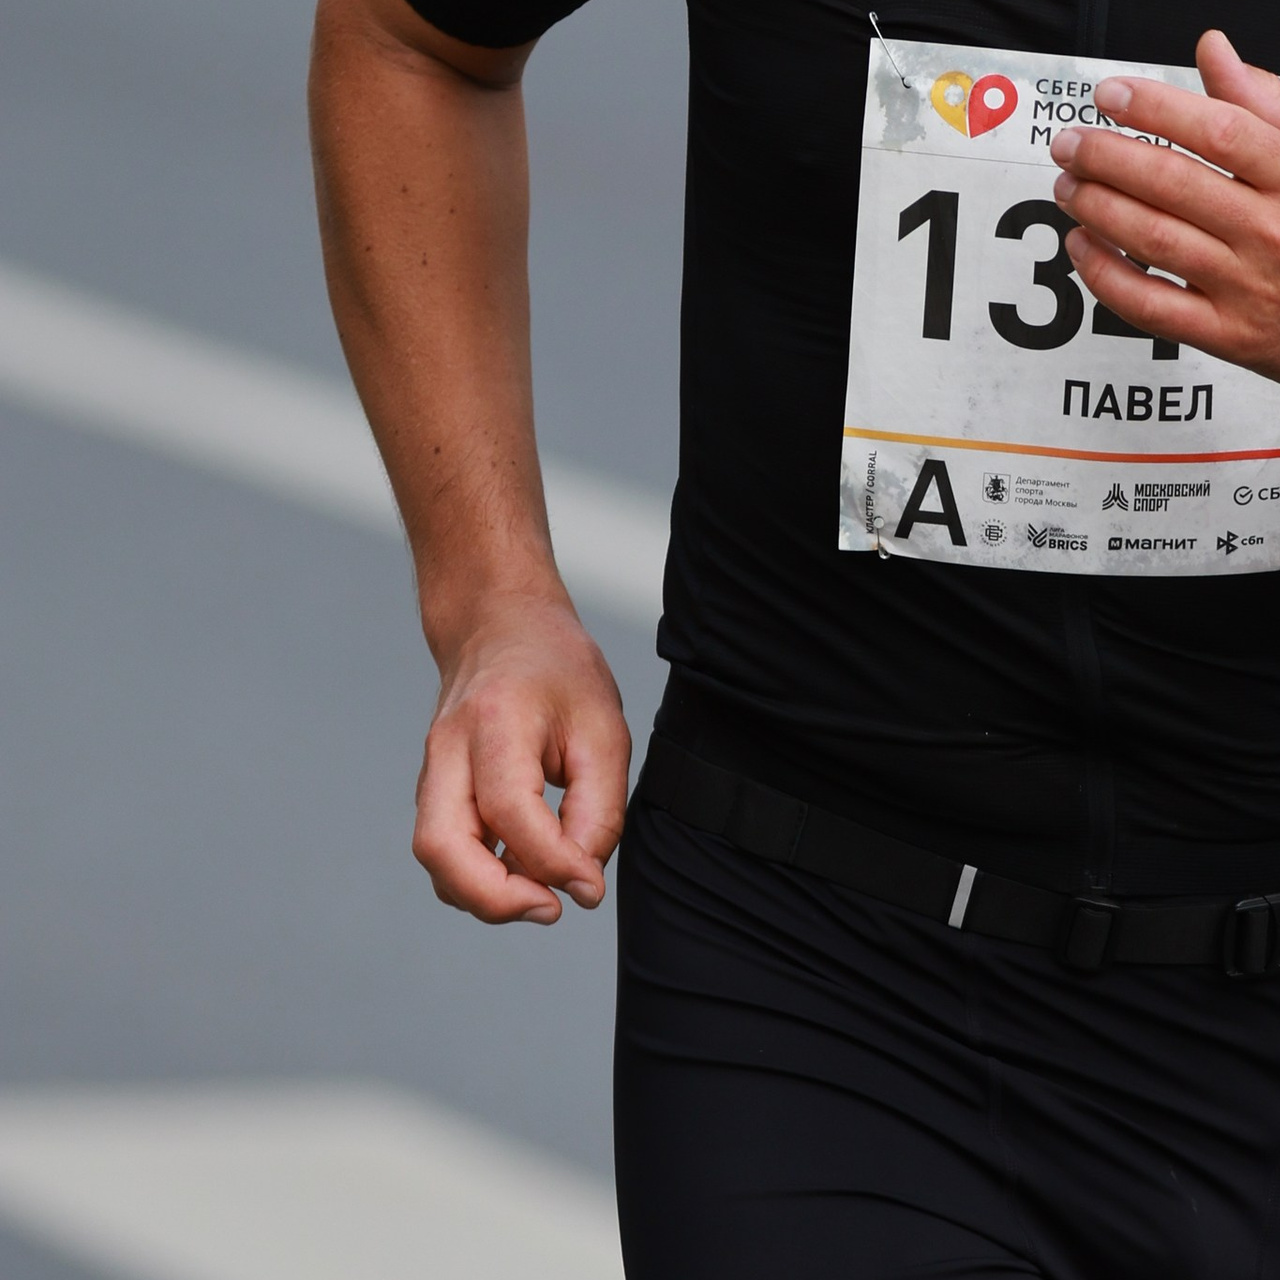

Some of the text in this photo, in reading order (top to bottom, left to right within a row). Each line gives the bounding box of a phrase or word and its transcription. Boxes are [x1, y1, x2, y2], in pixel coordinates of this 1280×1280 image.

[1062, 378, 1214, 422] ПАВЕЛ
[866, 450, 878, 488] CORRAL
[1015, 476, 1070, 488] Департамент
[1134, 480, 1211, 497] МОСКОВСКИЙ
[1015, 487, 1044, 496] спорта
[1014, 496, 1078, 508] города Москвы
[1133, 498, 1170, 512] СПОРТ
[865, 494, 876, 535] КЛАСТЕР
[1048, 539, 1088, 551] BRICS
[1240, 535, 1264, 546] сбп
